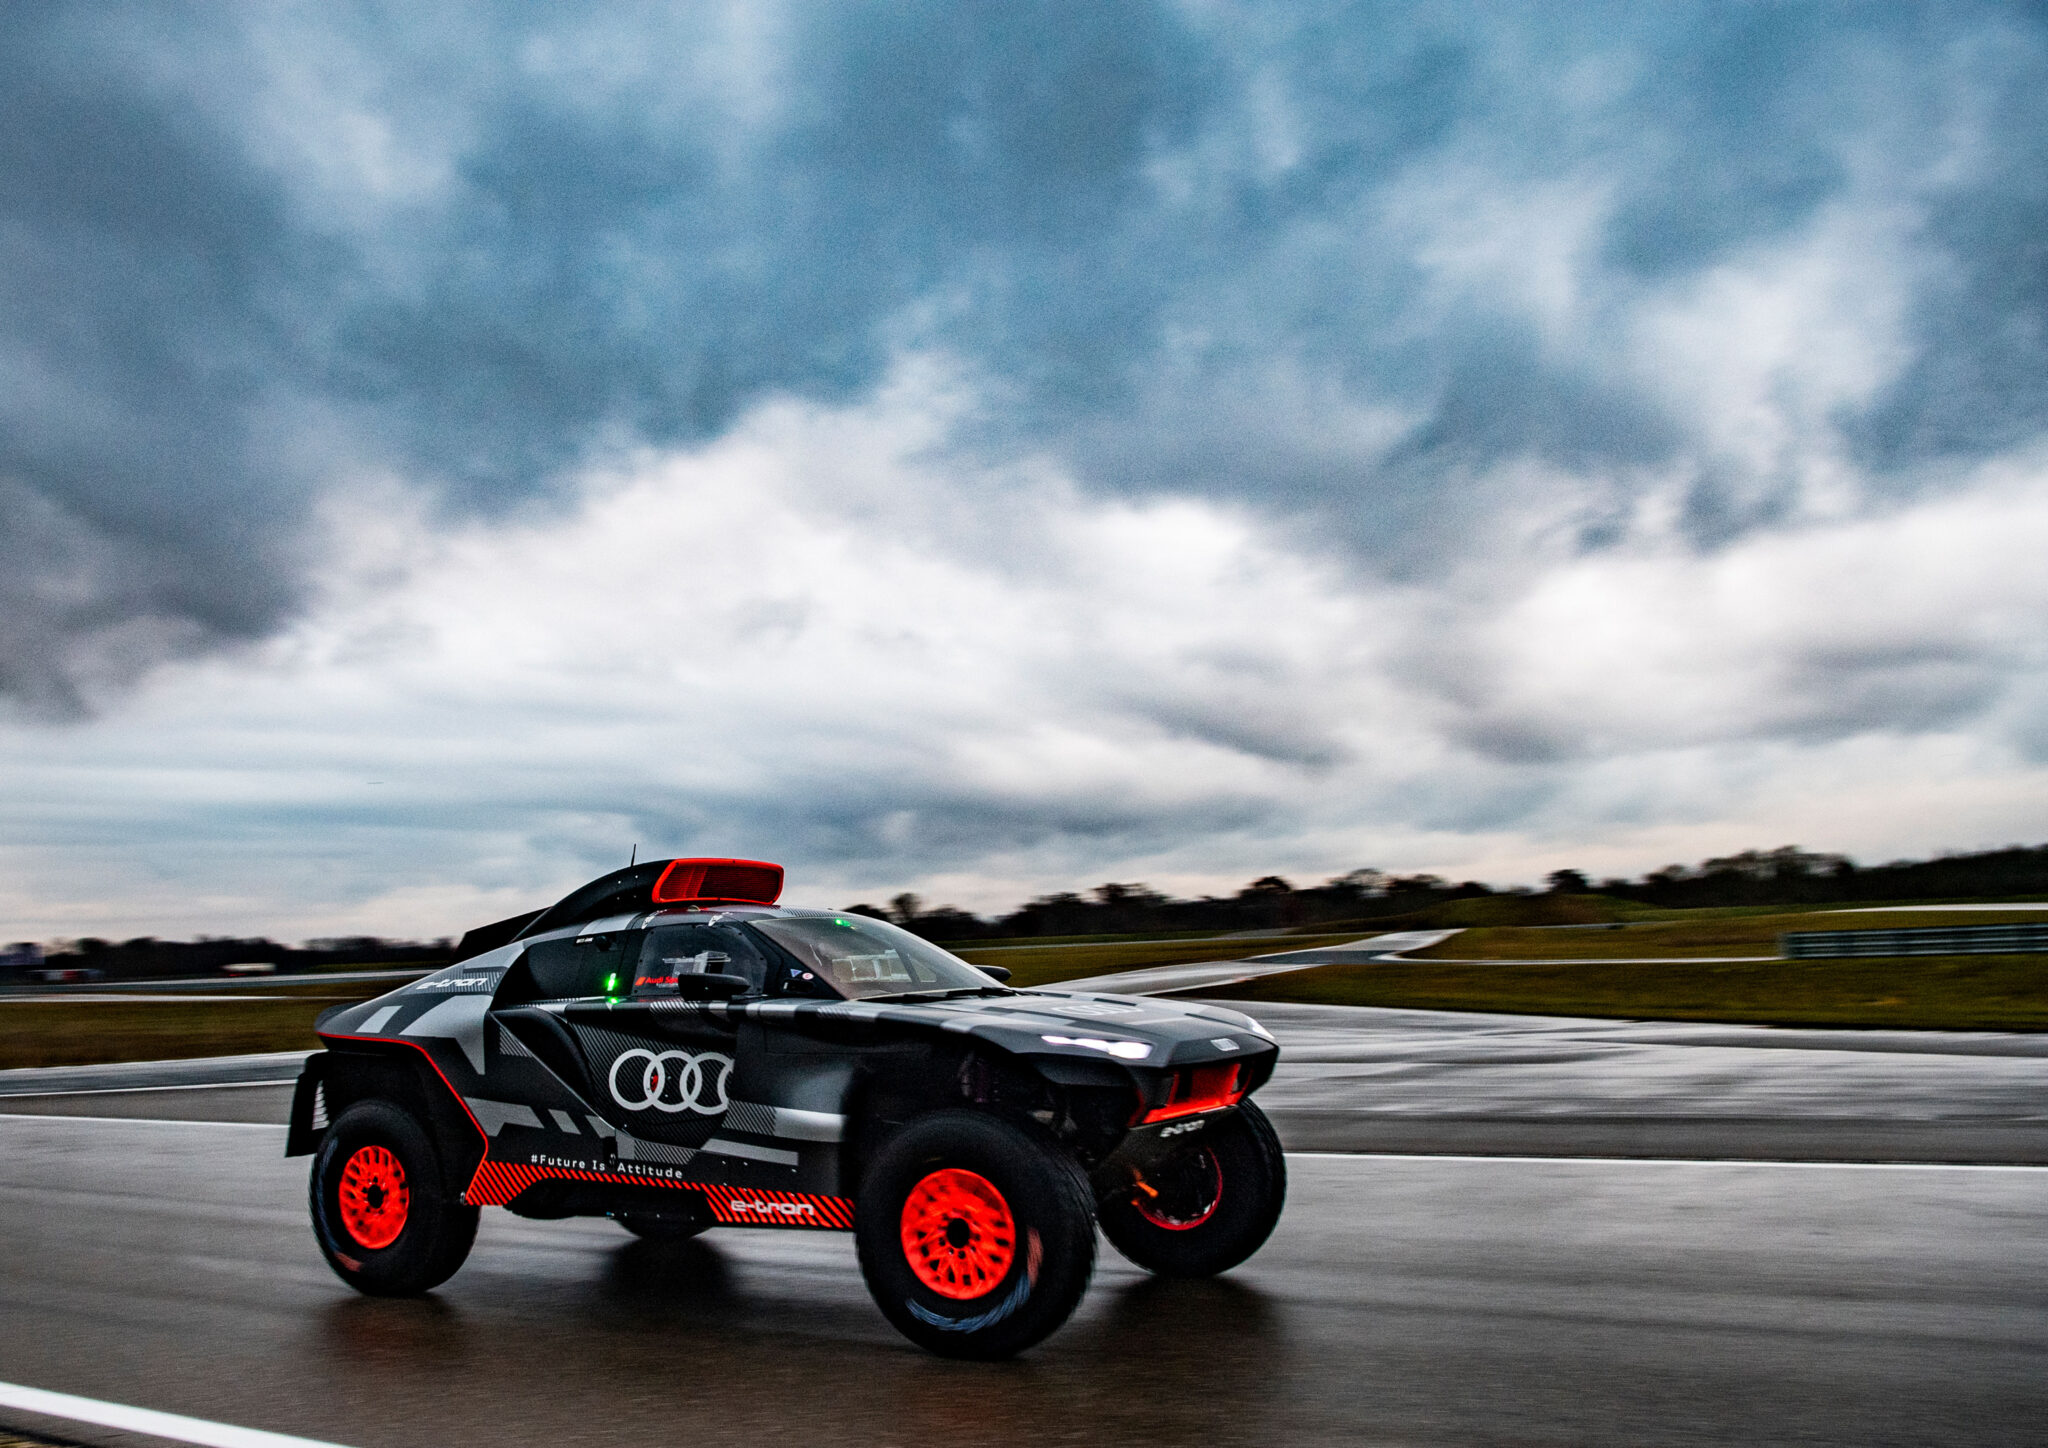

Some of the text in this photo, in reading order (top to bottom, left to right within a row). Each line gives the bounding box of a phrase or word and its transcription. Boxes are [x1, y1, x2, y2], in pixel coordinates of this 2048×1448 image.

[645, 976, 664, 984] Audi
[530, 1154, 683, 1179] #Future Is Attitude
[731, 1199, 815, 1216] e-tron
